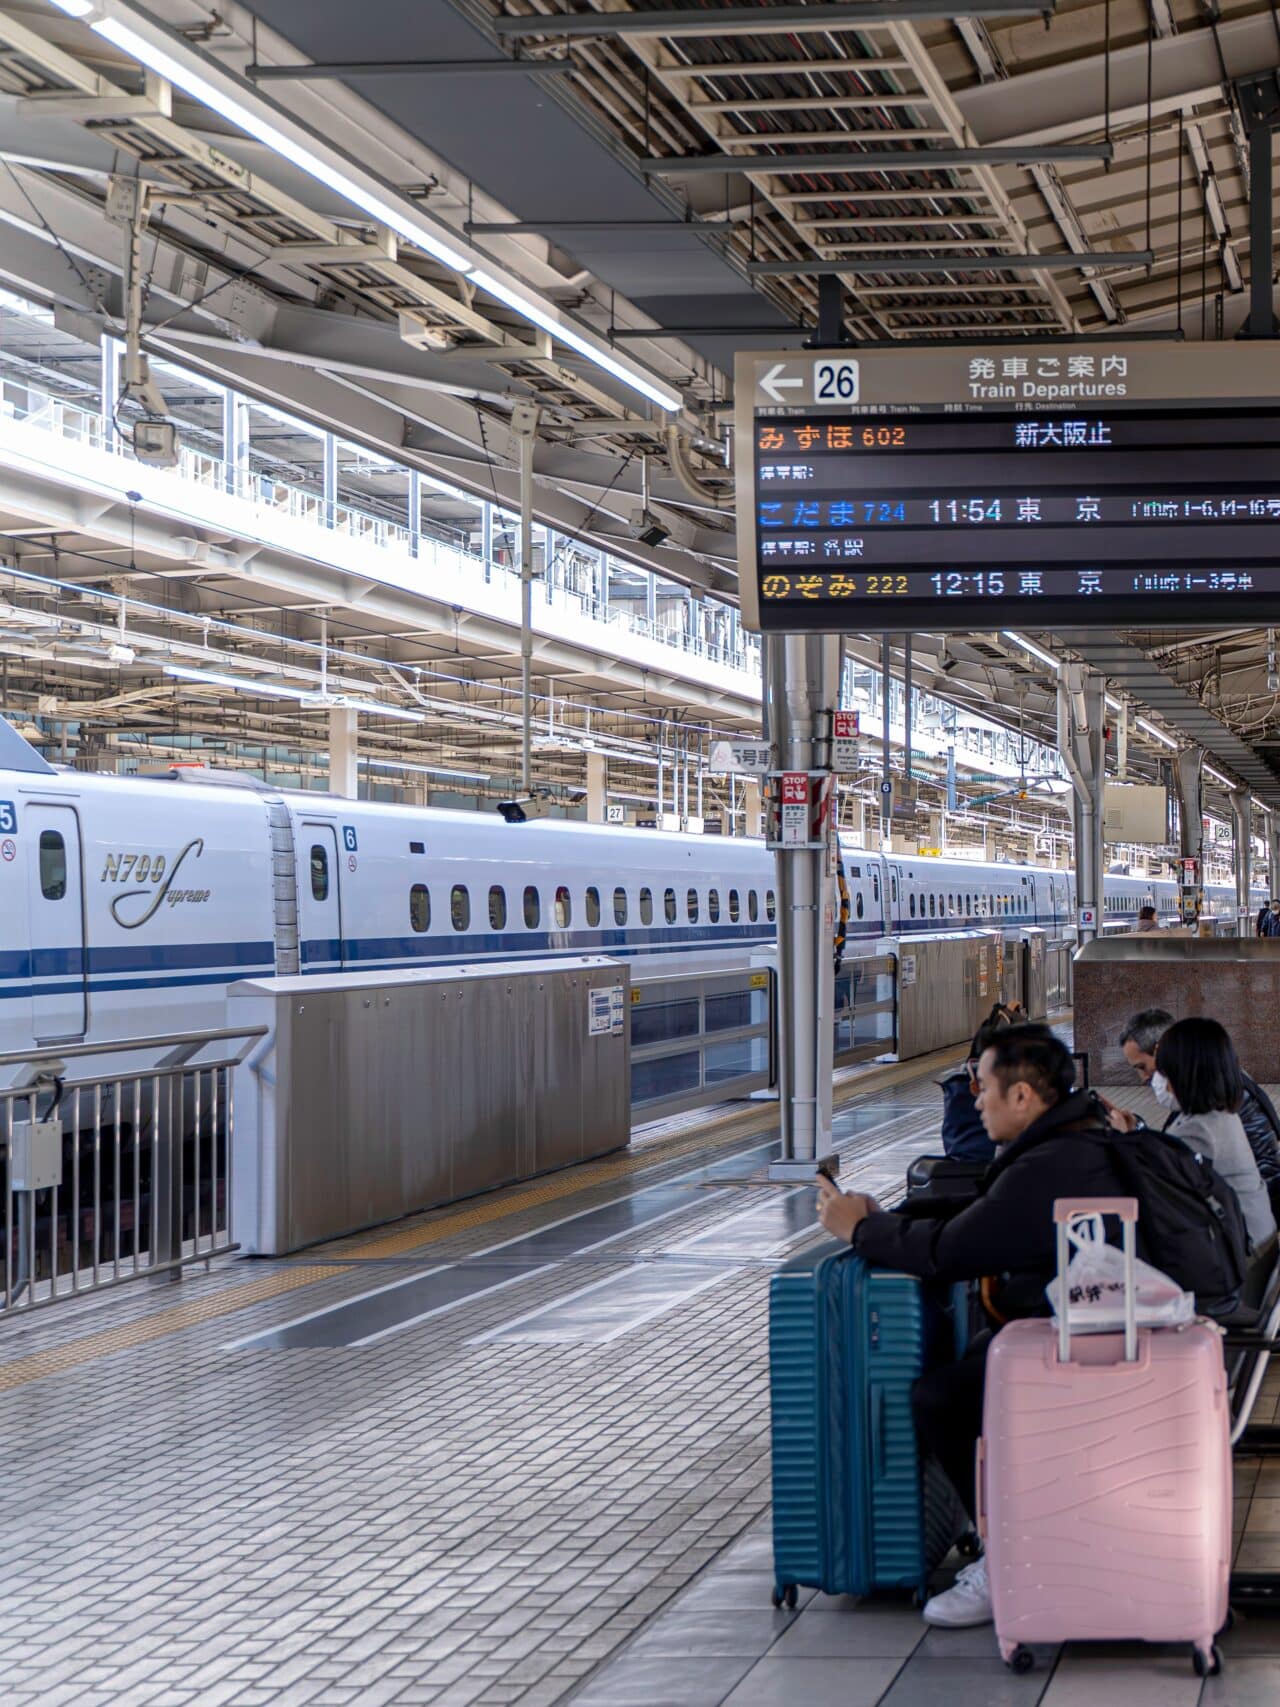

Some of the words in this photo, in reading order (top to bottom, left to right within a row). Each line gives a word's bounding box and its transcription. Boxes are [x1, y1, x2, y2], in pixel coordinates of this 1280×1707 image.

[969, 356, 1128, 379] 発車ご案内
[818, 366, 854, 398] 26
[969, 382, 1016, 399] Train
[1023, 381, 1127, 398] Departures
[788, 407, 806, 416] Train
[889, 405, 907, 414] Train
[965, 404, 983, 412] Time
[759, 425, 853, 450] みずほ
[863, 428, 905, 446] 602
[1015, 421, 1112, 448] 新大阪止
[760, 500, 855, 526] こだま
[863, 503, 906, 522] 724
[928, 499, 1003, 522] 11:54
[1017, 496, 1102, 522] 東京
[762, 573, 856, 599] のぞみ
[866, 575, 909, 594] 222
[930, 572, 1004, 595] 12:15
[1018, 571, 1103, 595] 東京
[836, 711, 857, 720] STOP
[783, 776, 806, 784] STOP
[882, 784, 890, 792] 6
[0, 804, 13, 830] 5
[609, 808, 621, 819] 27
[345, 829, 355, 849] 6
[1218, 827, 1230, 838] 26
[100, 853, 166, 882] N700
